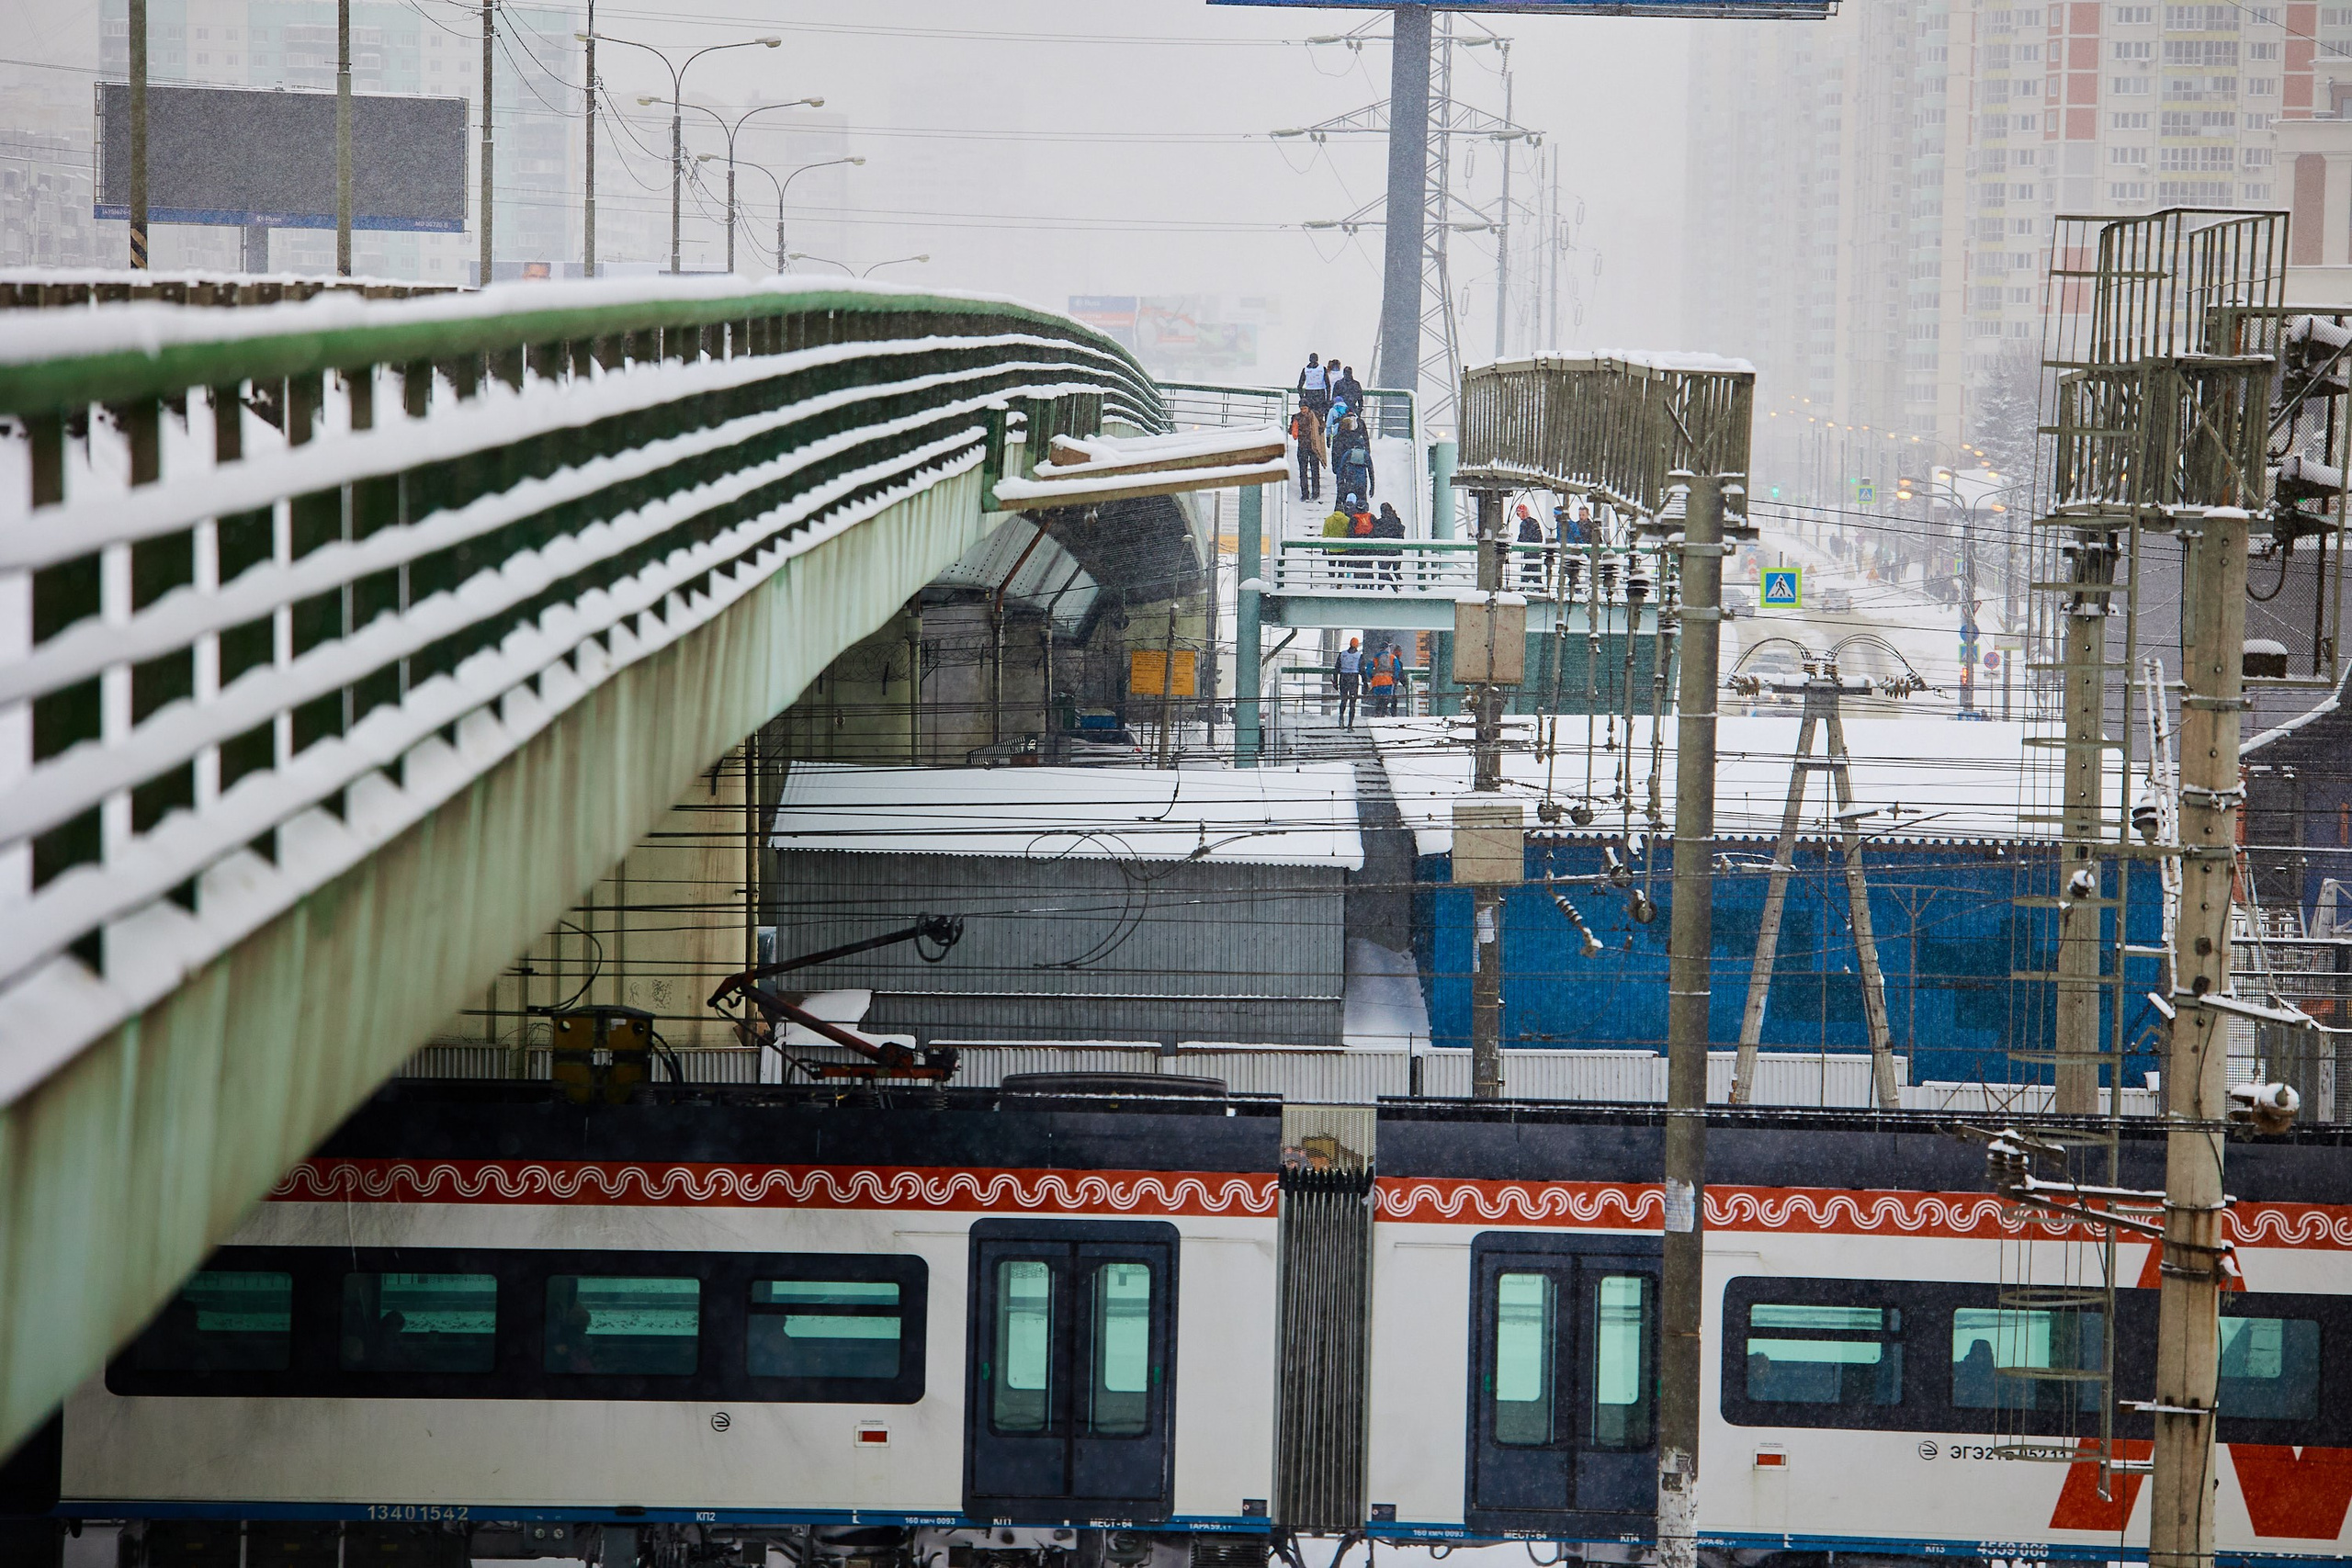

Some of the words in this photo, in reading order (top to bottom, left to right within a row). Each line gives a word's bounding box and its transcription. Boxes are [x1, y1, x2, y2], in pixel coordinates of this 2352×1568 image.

[695, 1511, 716, 1521] КП2
[936, 1517, 956, 1525] 0093
[1620, 1532, 1640, 1543] КП4
[1925, 1542, 1946, 1553] КП3
